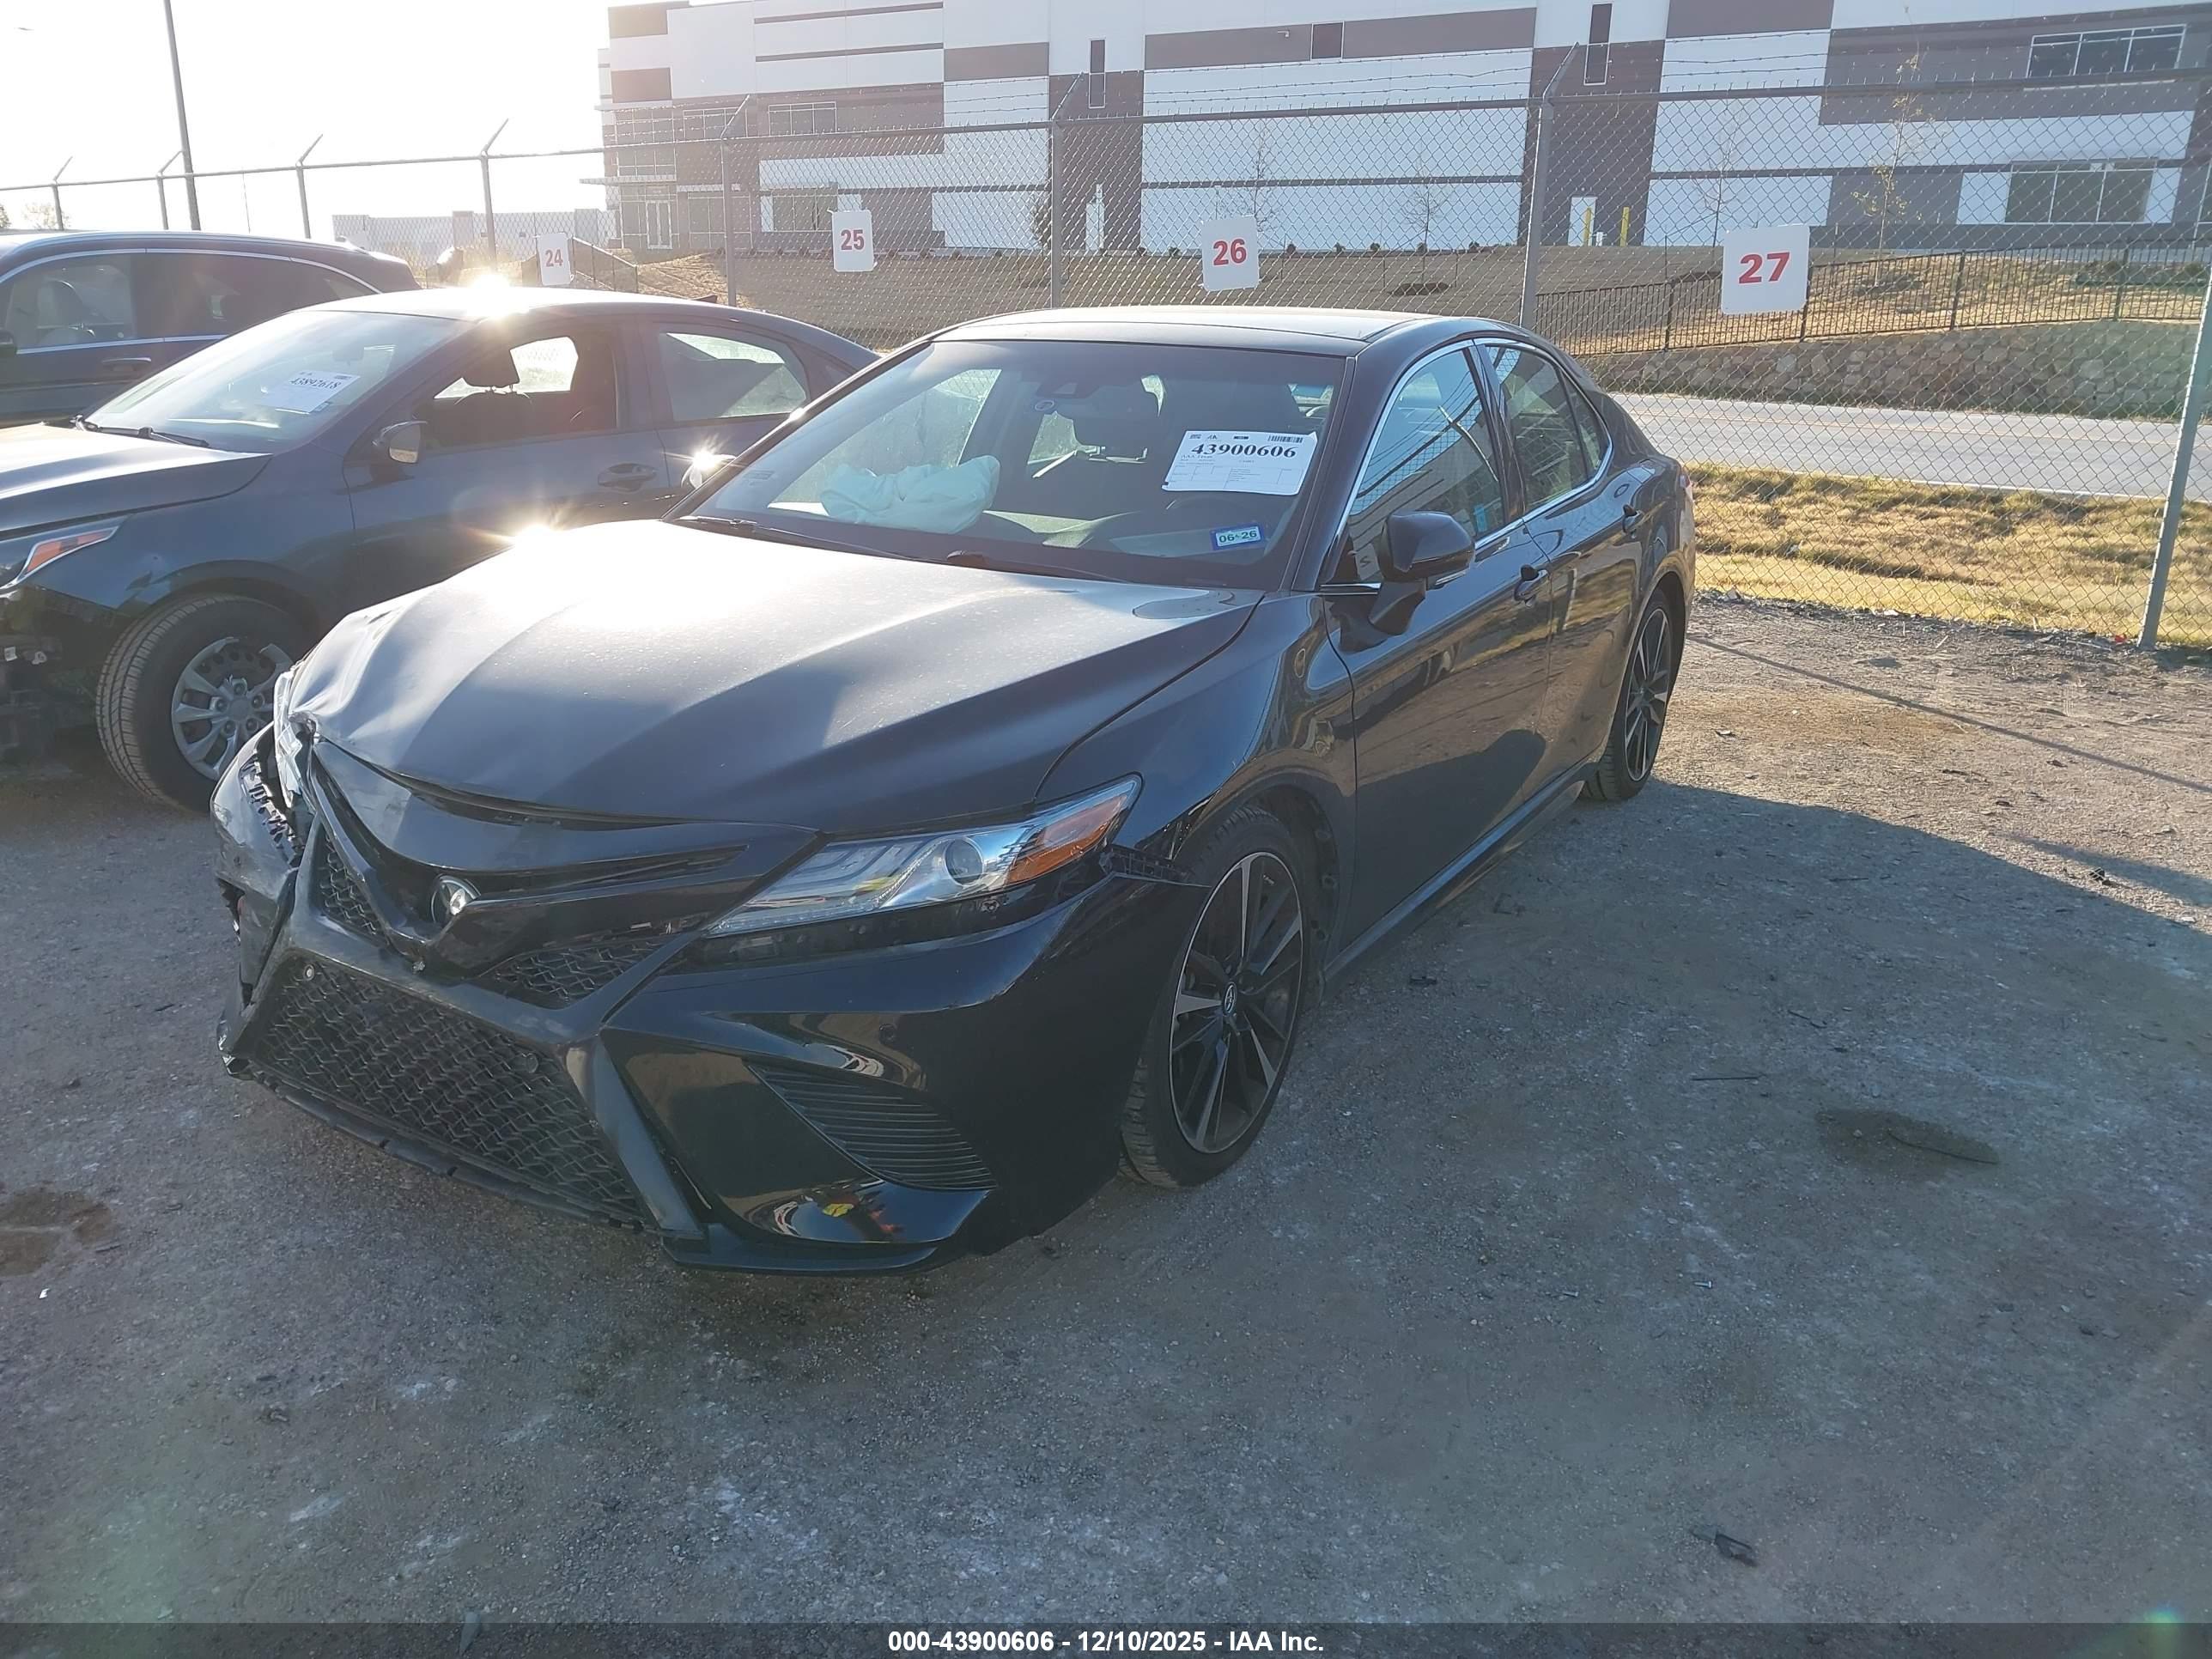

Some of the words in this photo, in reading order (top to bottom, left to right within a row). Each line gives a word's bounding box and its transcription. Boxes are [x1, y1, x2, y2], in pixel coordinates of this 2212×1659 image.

[840, 228, 865, 251] 25
[544, 248, 563, 268] 24
[1212, 238, 1247, 266] 26
[1738, 252, 1790, 284] 27
[1191, 444, 1298, 458] 43900606
[1218, 533, 1235, 544] 06
[1241, 530, 1258, 539] 26
